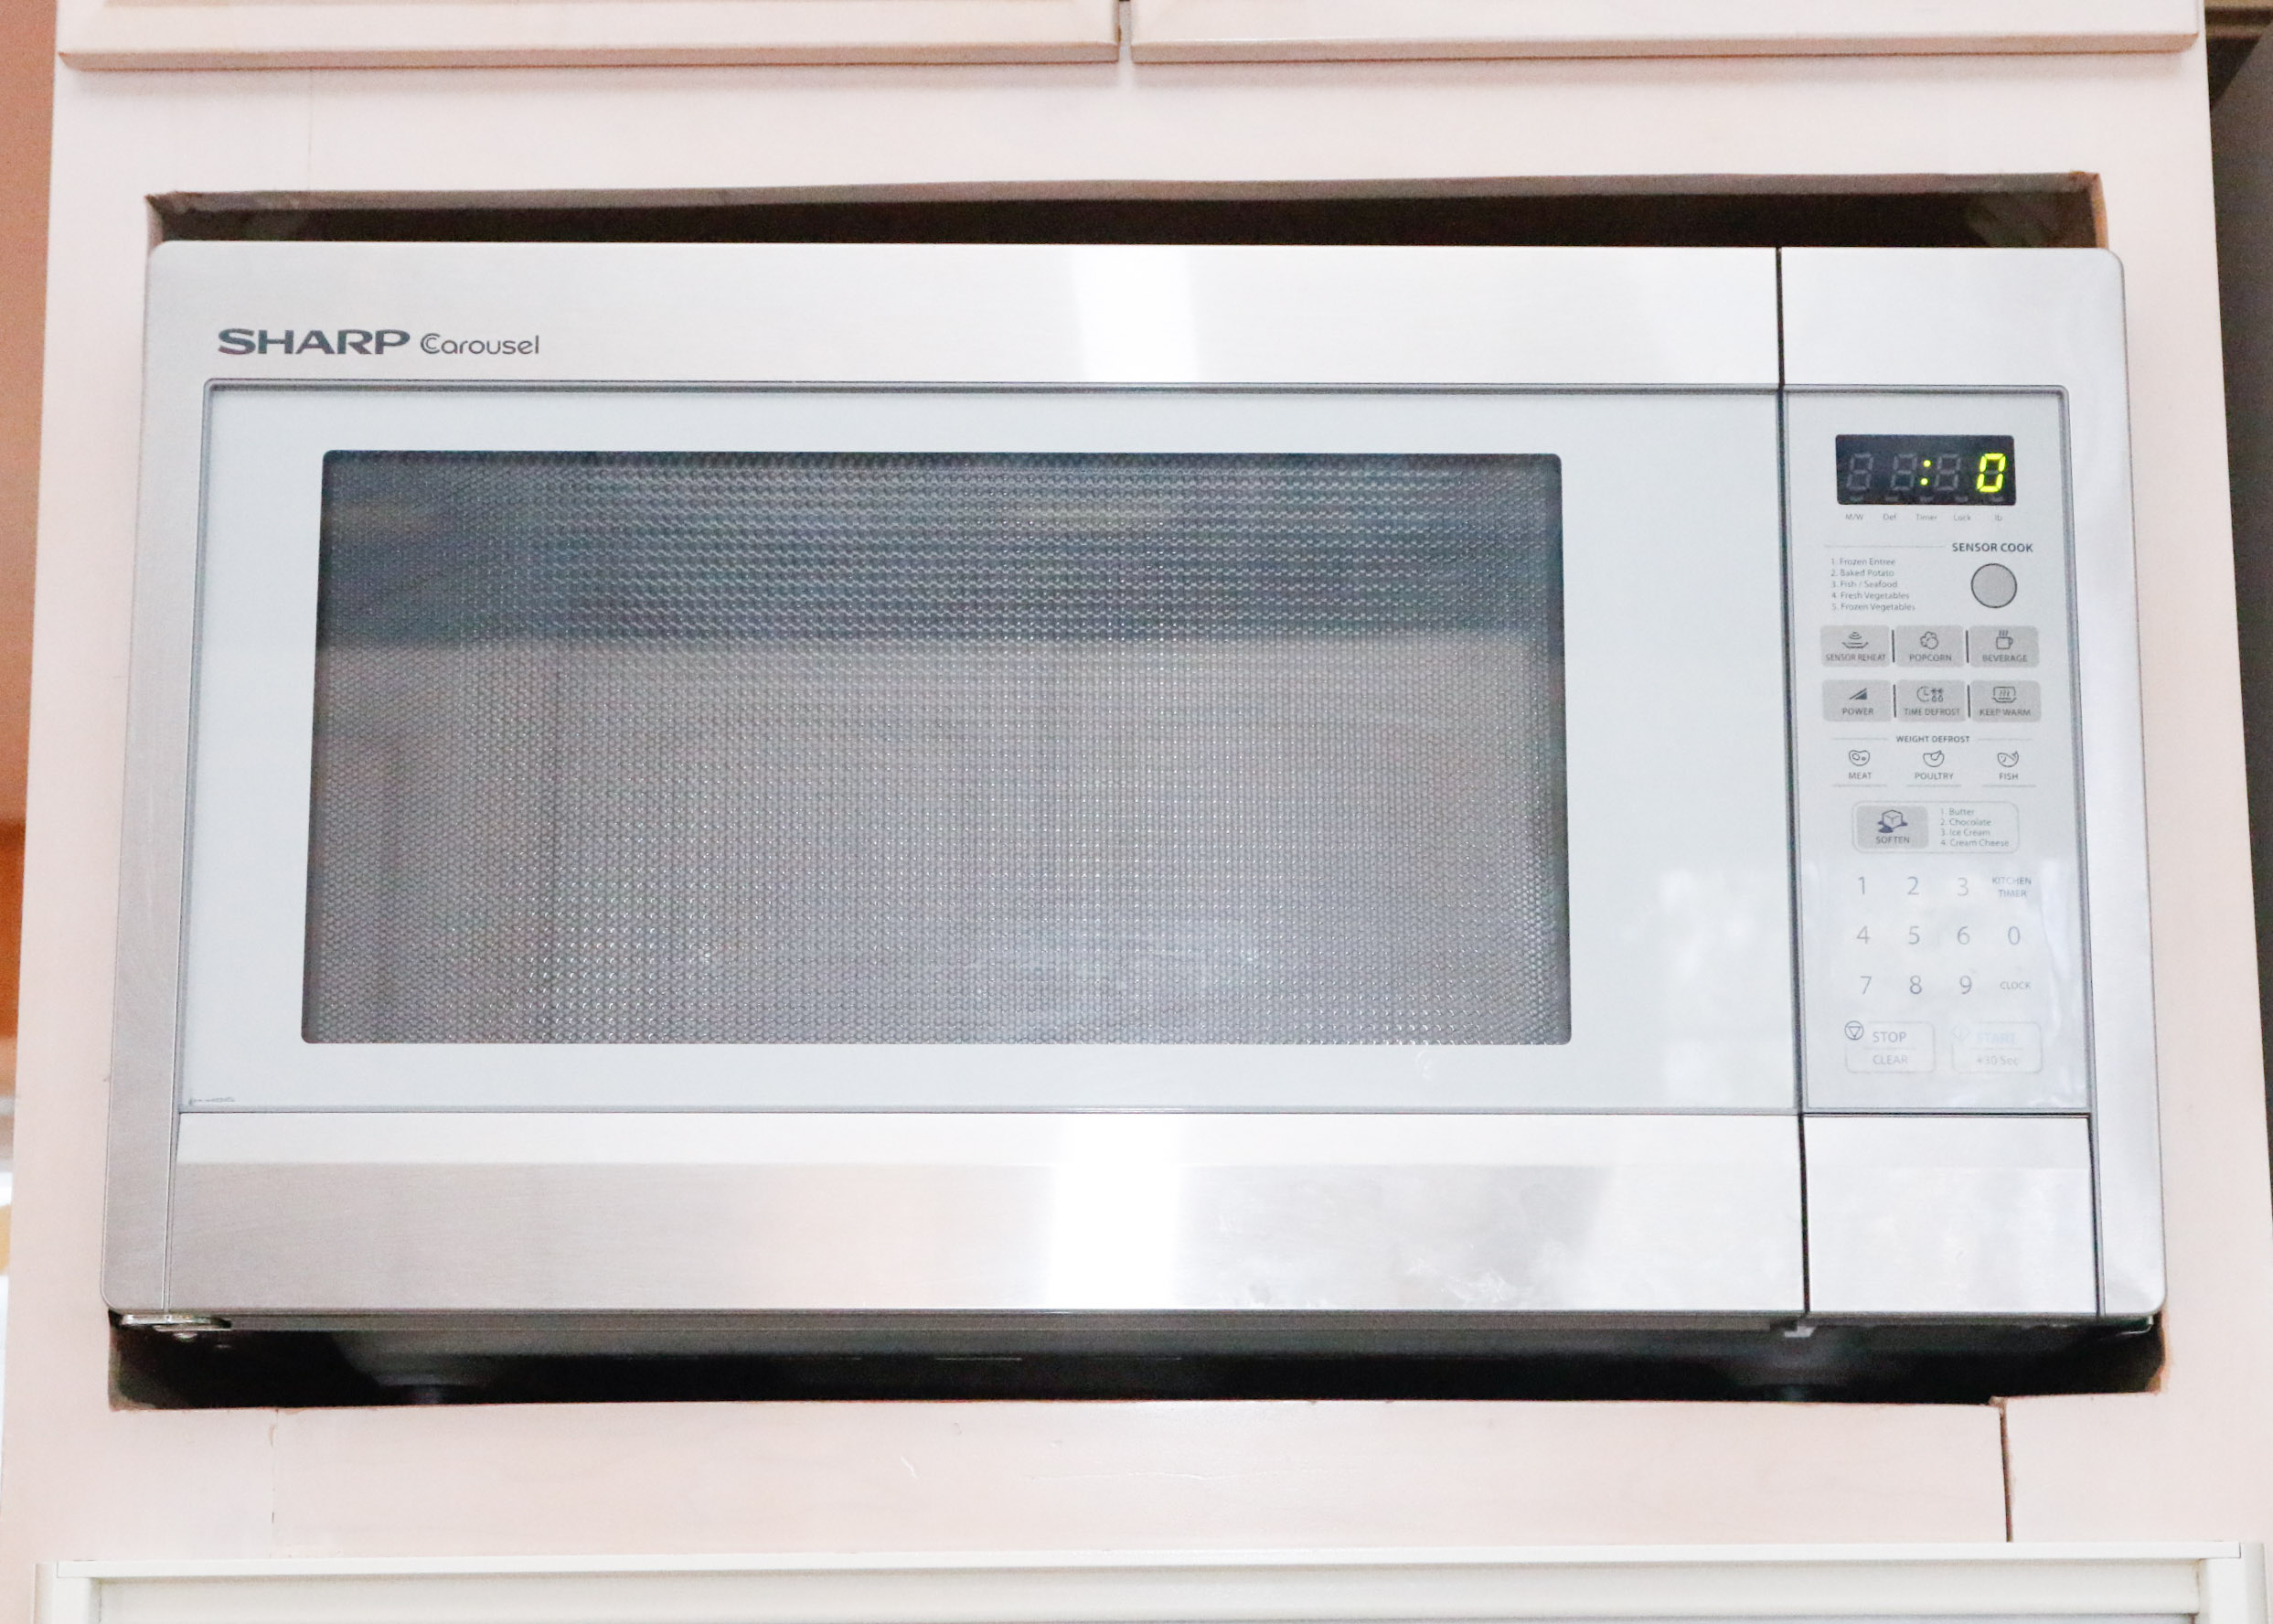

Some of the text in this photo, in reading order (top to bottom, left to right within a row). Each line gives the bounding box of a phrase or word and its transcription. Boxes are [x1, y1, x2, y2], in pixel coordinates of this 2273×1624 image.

[218, 327, 539, 355] SHARP Carousel
[1952, 542, 2033, 552] SENSOR COOK
[1840, 569, 1865, 577] Baked
[1864, 592, 1909, 601] Vegetables
[1870, 604, 1916, 612] Vegetables
[1825, 653, 1886, 661] SENSOR REHEAT
[1909, 654, 1952, 662] POPCORN
[1982, 654, 2028, 663] BEVERAGE
[1842, 708, 1874, 716] POWER
[1905, 708, 1960, 717] TIME DEFROST
[1980, 708, 2032, 717] KEEP WARM
[1895, 735, 1970, 743] WEIGHT DEFROST
[1848, 772, 1872, 780] MEAT
[1915, 772, 1954, 780] POULTRY
[1999, 773, 2019, 781] FISH
[1948, 807, 1974, 816] Butter
[1875, 836, 1910, 845] SOFTEN
[1858, 876, 1866, 894] 1
[1991, 877, 2032, 885] KITCHEN
[1907, 877, 1919, 895] 2
[1957, 877, 1969, 896] 3
[1998, 890, 2027, 898] TIMER
[1856, 925, 1871, 944] 4
[1908, 926, 1920, 945] 5
[1957, 926, 1970, 945] 6
[2008, 926, 2021, 946] 0
[1860, 976, 1873, 994] 7
[1909, 976, 1923, 995] 8
[1959, 976, 1972, 995] 9
[2000, 981, 2032, 989] CLOCK
[1873, 1031, 1906, 1042] STOP
[1873, 1055, 1908, 1064] CLEAR
